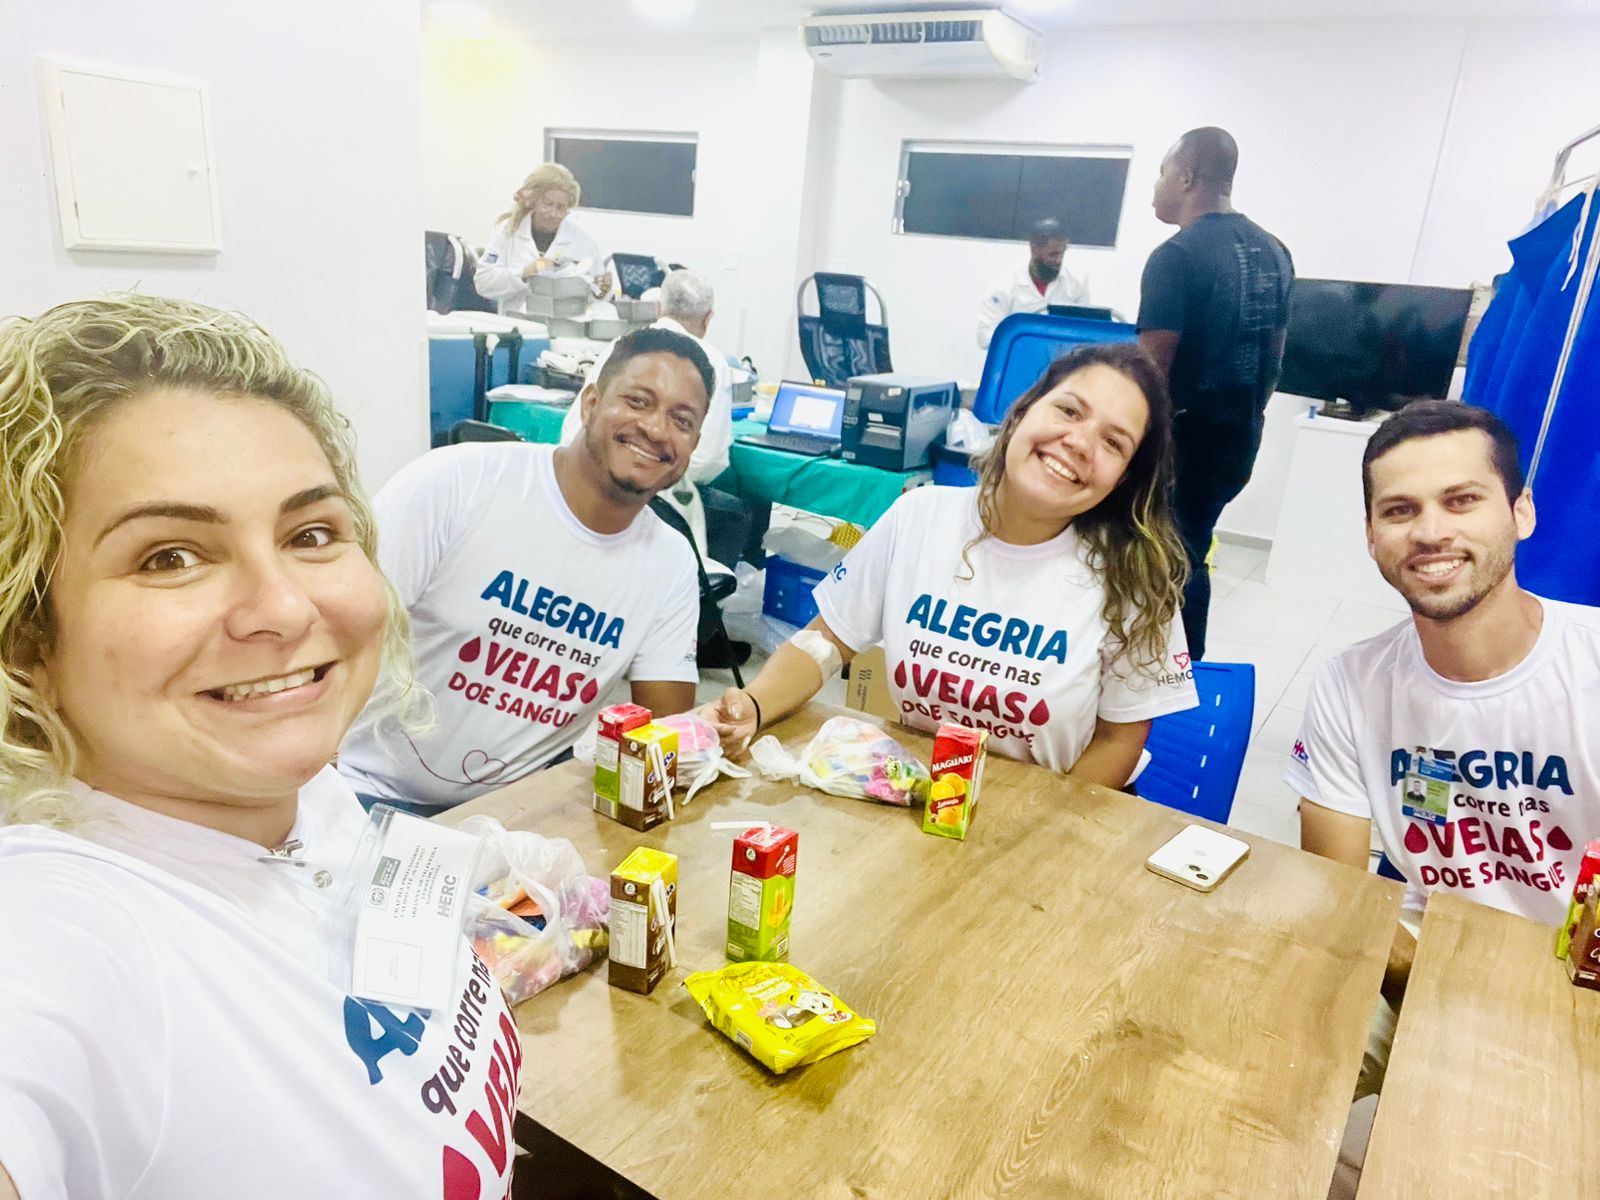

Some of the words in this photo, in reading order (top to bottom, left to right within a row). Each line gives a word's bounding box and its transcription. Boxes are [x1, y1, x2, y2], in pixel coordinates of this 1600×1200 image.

[480, 569, 625, 649] ALEGRIA
[905, 593, 1069, 665] ALEGRIA
[488, 617, 522, 639] que
[525, 630, 567, 657] corre
[569, 648, 601, 668] nas
[908, 638, 943, 658] que
[948, 649, 998, 676] corre
[1005, 665, 1042, 687] nas
[449, 671, 496, 706] DOE
[484, 641, 586, 702] VEIAS
[911, 663, 1028, 725] VEIAS
[902, 700, 943, 721] DOE
[932, 754, 973, 774] MAGUARY
[1391, 748, 1574, 795] AEGRIA
[1454, 794, 1511, 817] corre
[1428, 817, 1545, 864] VEIAS
[436, 874, 458, 918] HERC
[1420, 864, 1475, 889] DOE
[1479, 860, 1566, 892] SANGUE
[421, 1044, 471, 1116] que
[454, 976, 488, 1052] corre
